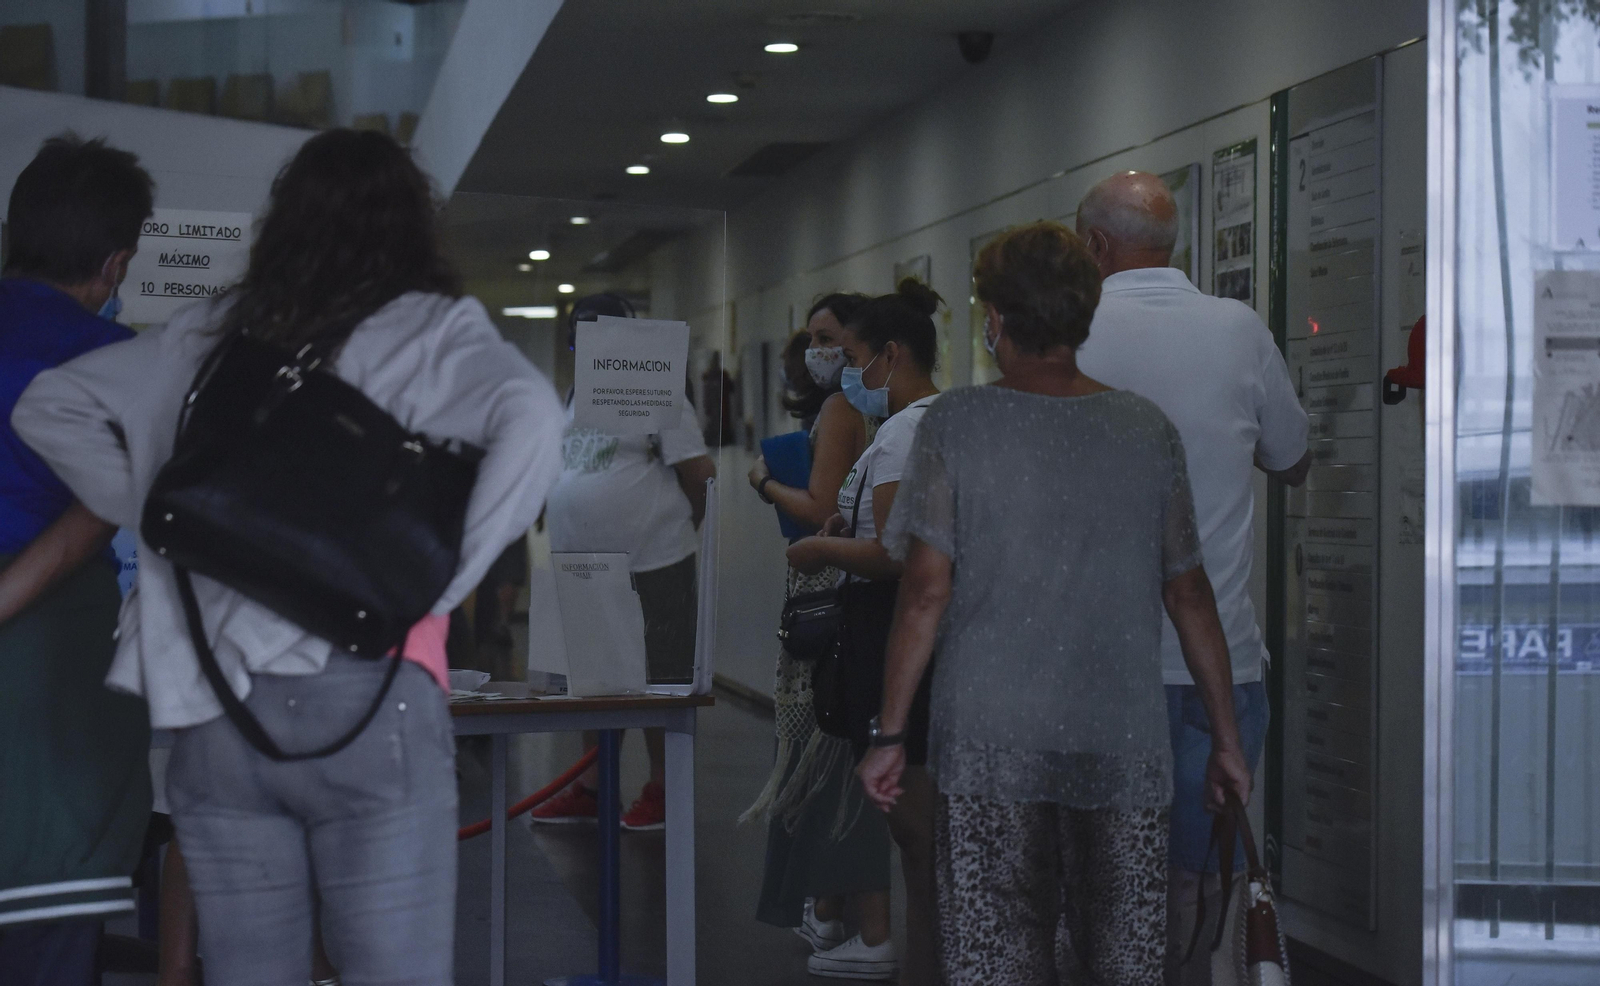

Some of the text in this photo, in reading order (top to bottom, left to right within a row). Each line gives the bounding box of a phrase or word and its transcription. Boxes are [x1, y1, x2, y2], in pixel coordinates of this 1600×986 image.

[143, 222, 241, 238] ORO LIMITADO
[159, 248, 210, 266] MÁXIMO
[140, 281, 155, 293] 10
[593, 358, 671, 372] INFORMACION
[592, 387, 606, 395] POR
[625, 388, 646, 396] ESPERE
[654, 389, 672, 397] TURNO
[592, 398, 630, 406] RESPETANDO
[618, 409, 650, 417] SEGURIDAD
